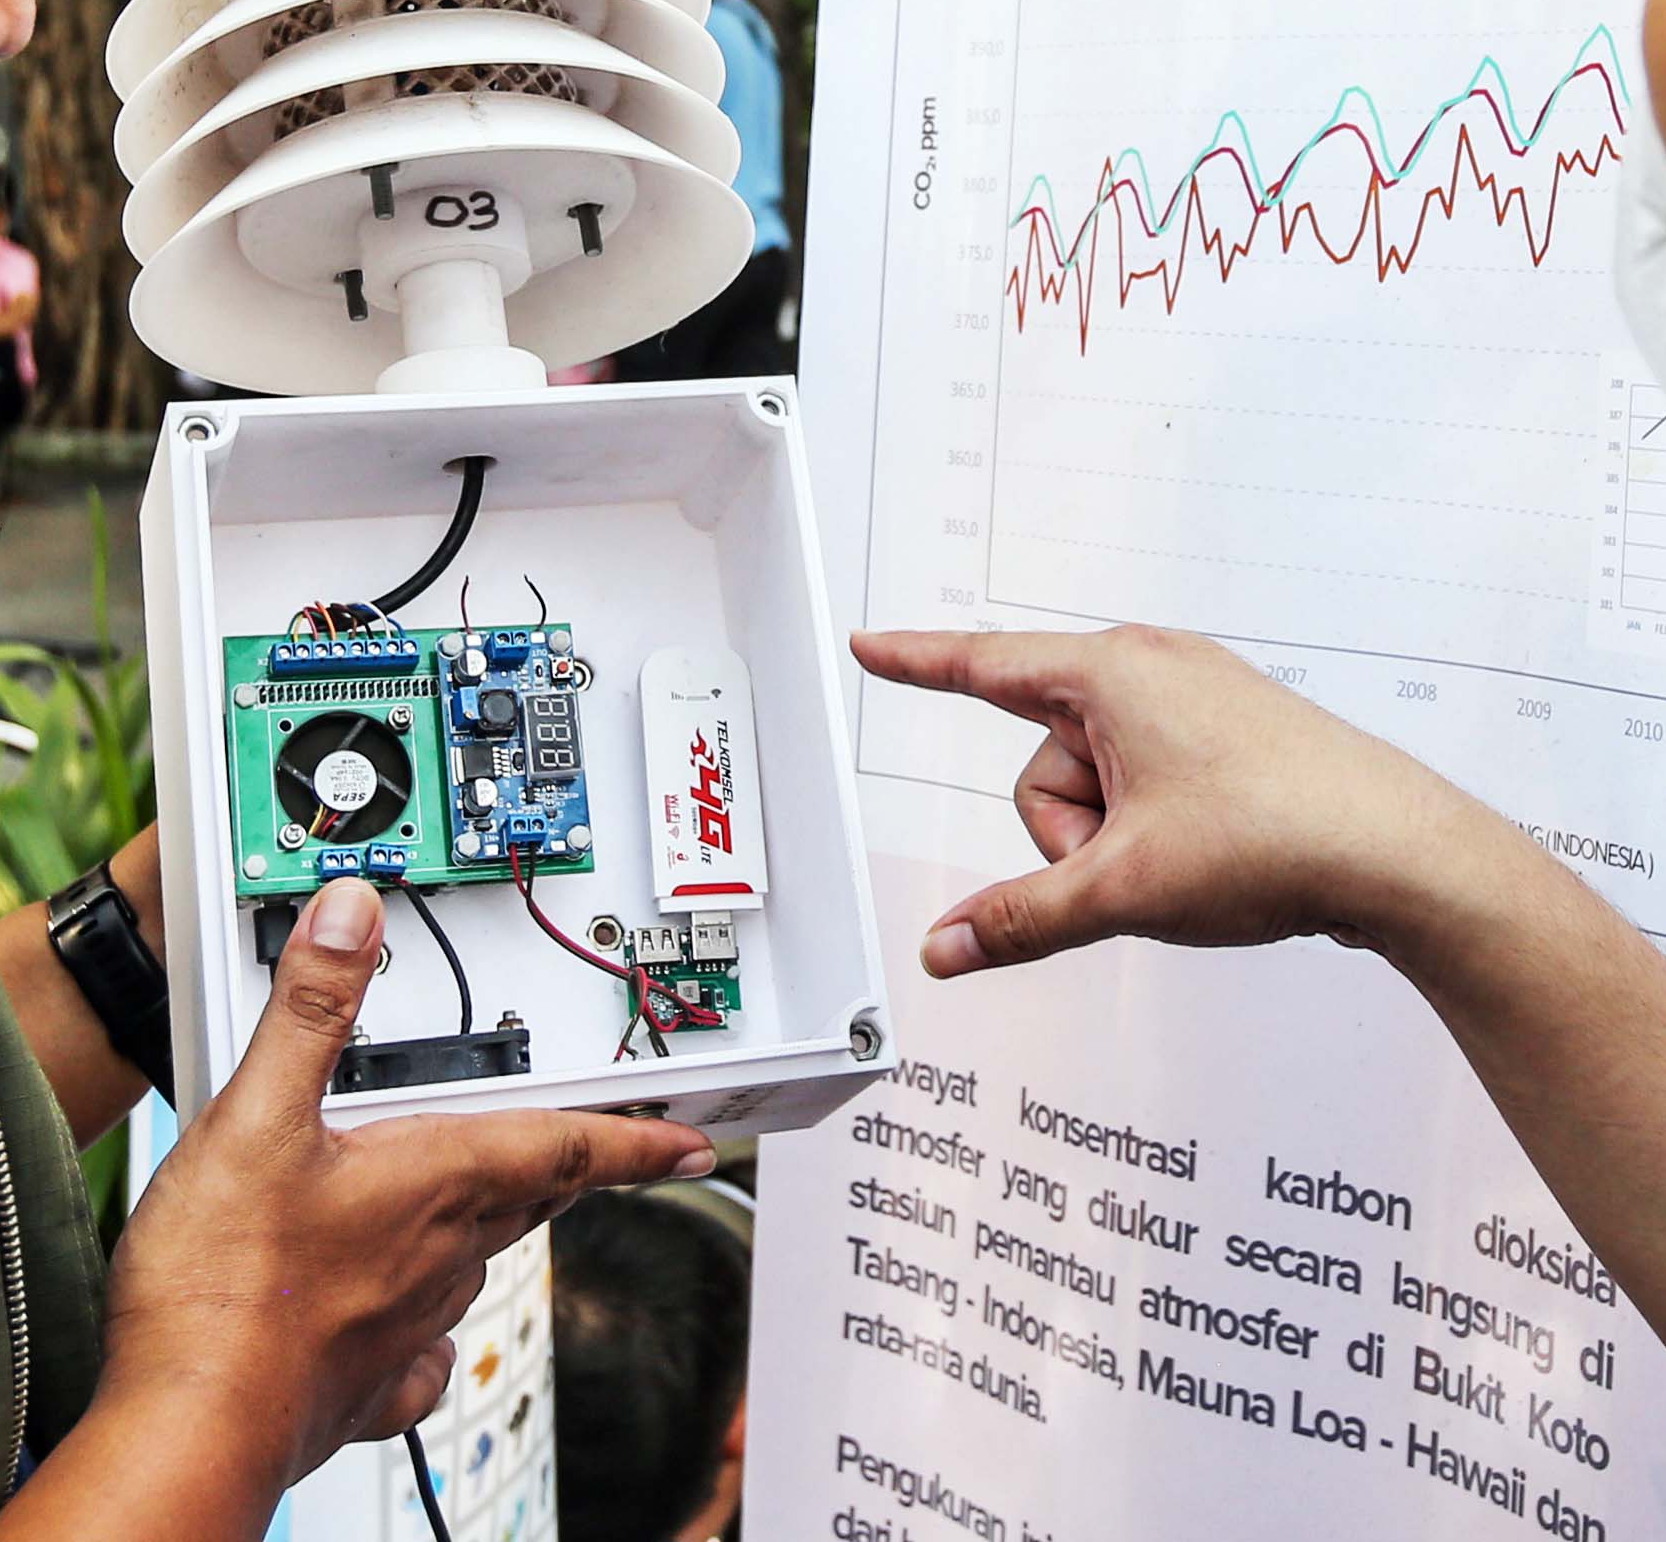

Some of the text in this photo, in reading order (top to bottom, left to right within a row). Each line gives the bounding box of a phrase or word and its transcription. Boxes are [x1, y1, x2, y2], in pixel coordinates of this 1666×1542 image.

[921, 96, 939, 150] ppm
[1626, 620, 1641, 631] JAN
[1265, 665, 1307, 685] 2007
[1396, 680, 1438, 701] 2008
[1517, 698, 1552, 720] 2009
[1624, 719, 1664, 742] 2010
[333, 792, 367, 802] SEPA
[690, 763, 732, 866] 4G LTE
[717, 719, 733, 805] TELKOMSEL
[1019, 1086, 1198, 1182] konsentrasi
[1266, 1156, 1412, 1230] karbon
[1474, 1213, 1617, 1307] dioksida
[852, 1112, 1615, 1389] atmosfer yang diukur secara langsung di
[842, 1311, 1047, 1424] rata-rata dunia.
[848, 1177, 1610, 1471] stasiun pemantau atmosfer di Bukit Koto
[846, 1236, 959, 1317] Tabang
[983, 1284, 1126, 1391] Indonesia,
[1138, 1349, 1275, 1427] Mauna
[1292, 1390, 1366, 1452] Loa
[1407, 1422, 1526, 1518] Hawaii
[1536, 1488, 1606, 1542] dan
[836, 1434, 1006, 1542] Pengukuran
